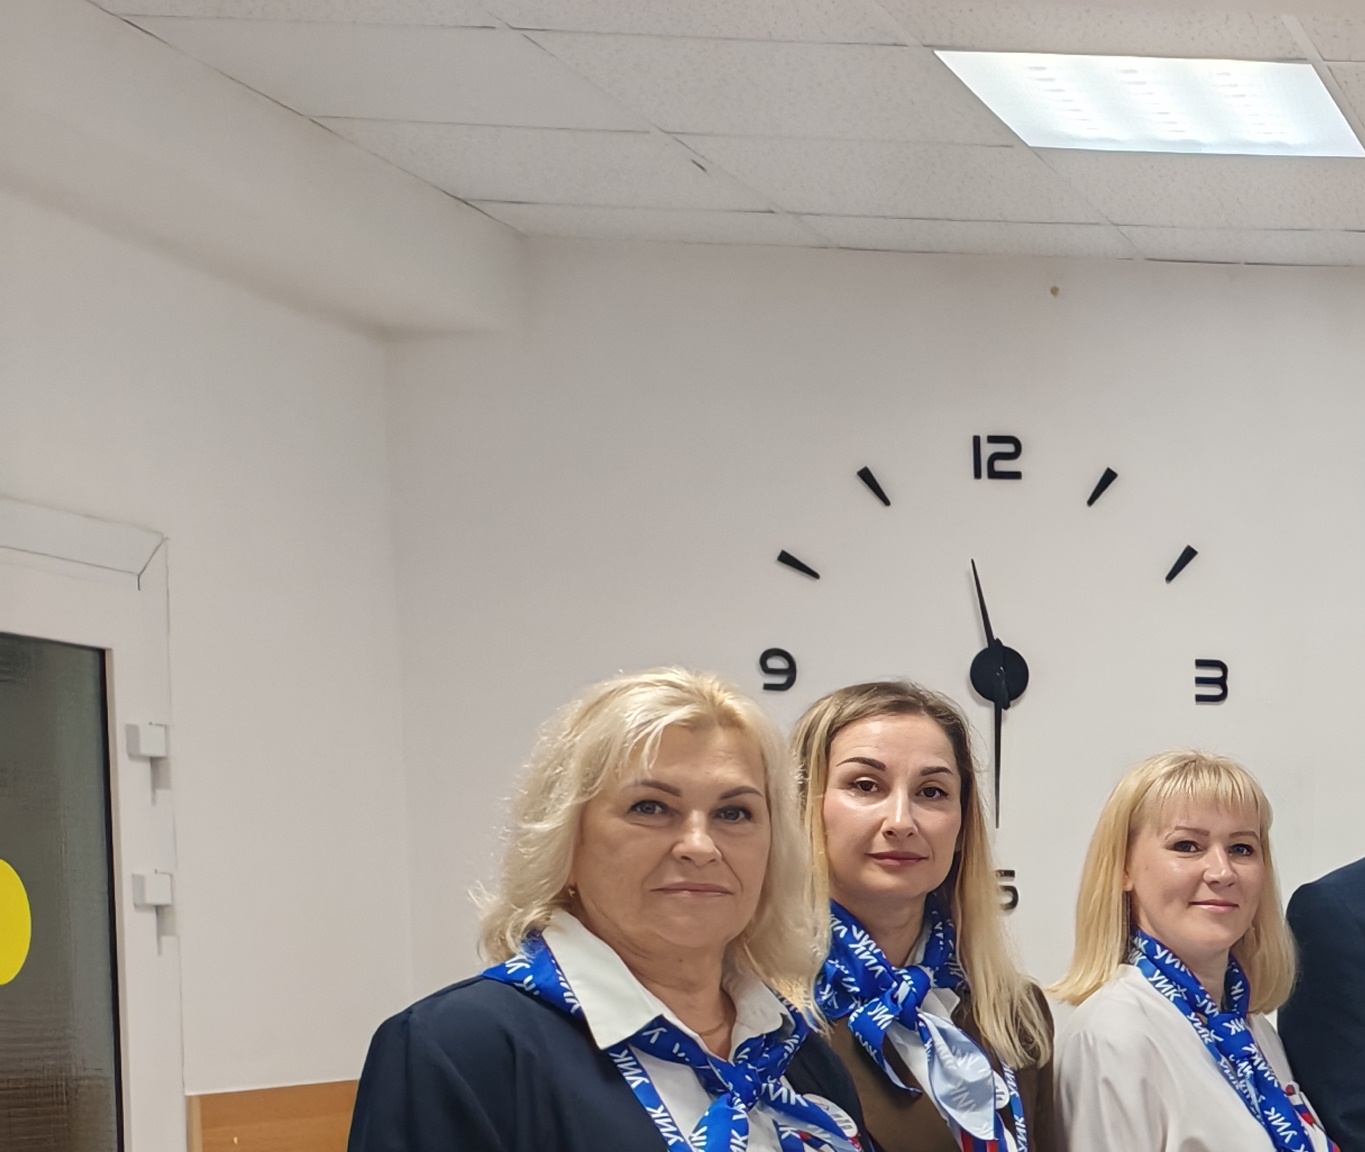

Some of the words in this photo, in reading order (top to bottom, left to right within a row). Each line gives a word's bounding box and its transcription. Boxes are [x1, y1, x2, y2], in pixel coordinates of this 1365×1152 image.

[972, 435, 1022, 480] 12
[759, 648, 797, 692] 9
[1194, 659, 1229, 705] 3
[1148, 969, 1182, 1002] УИК
[609, 1049, 650, 1089] УИК
[646, 1104, 685, 1146] УИК
[1263, 1107, 1298, 1144] УИК
